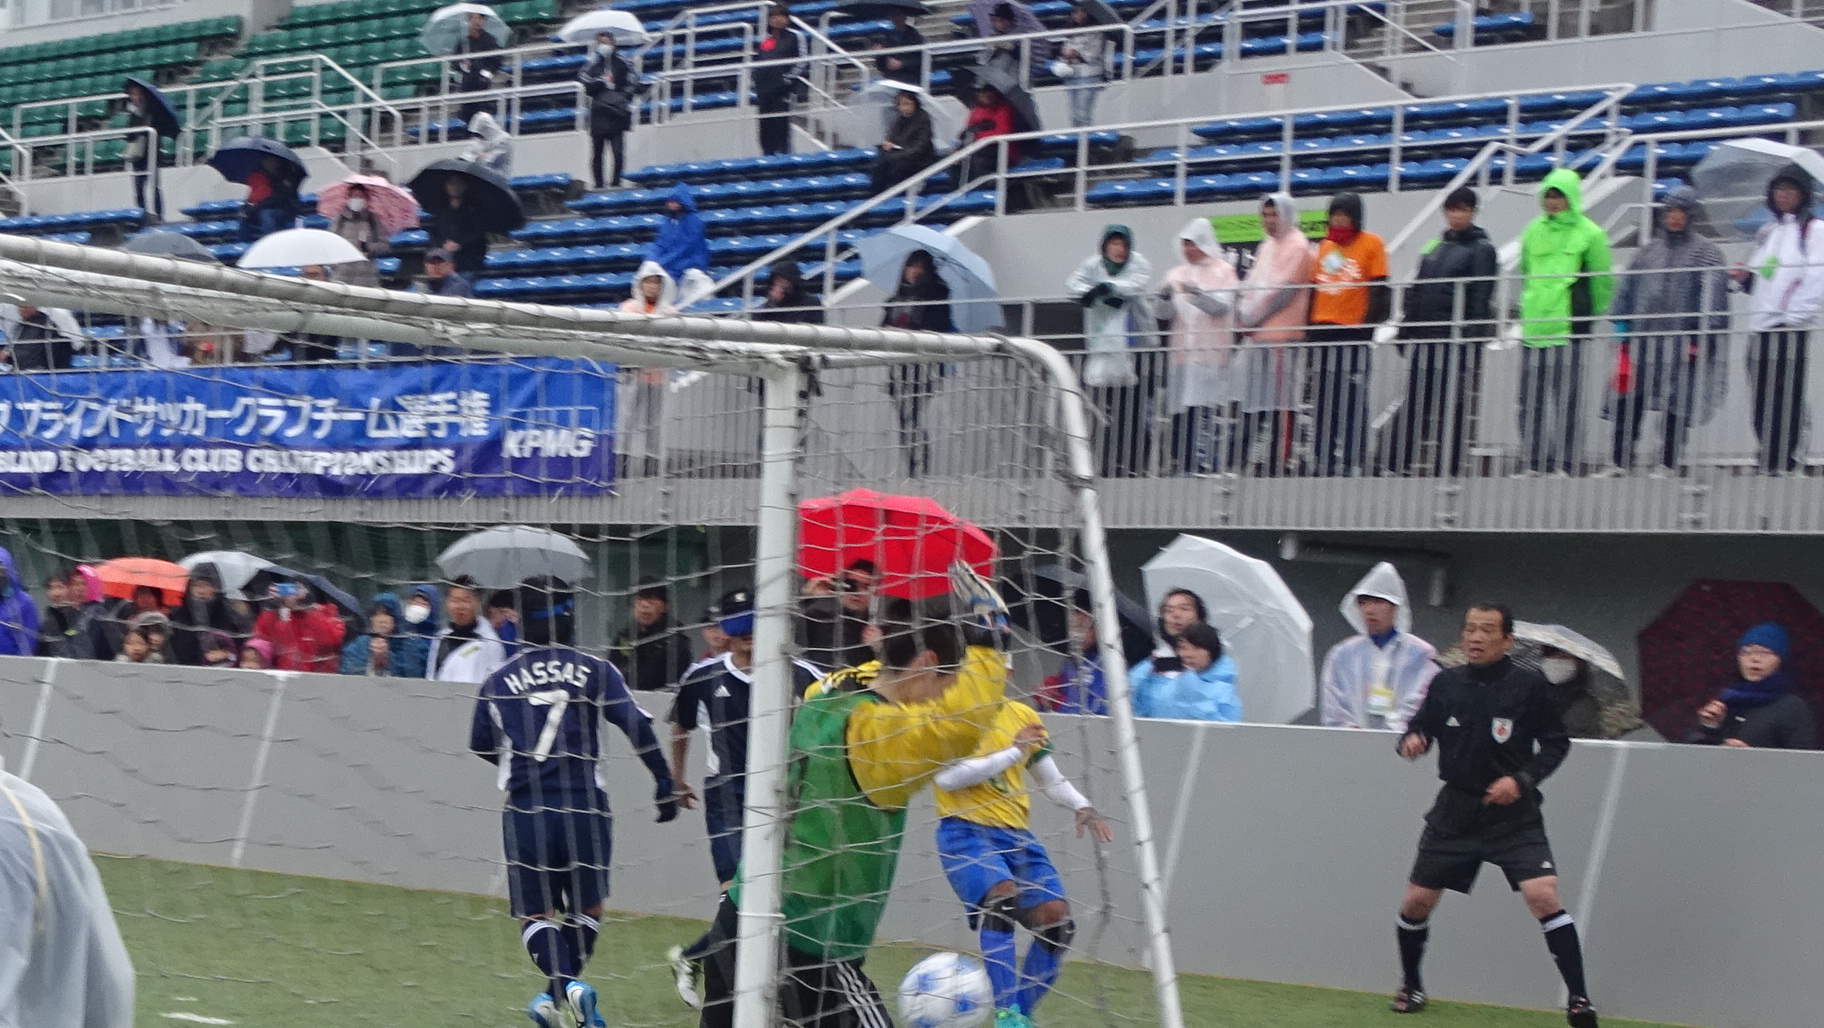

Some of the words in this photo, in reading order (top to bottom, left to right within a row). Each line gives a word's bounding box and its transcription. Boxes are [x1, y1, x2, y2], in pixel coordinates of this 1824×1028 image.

[501, 427, 597, 459] KPMG
[59, 449, 180, 473] FOOTBALL
[180, 448, 243, 473] CLUB
[245, 448, 456, 475] CHAMPIONSHIPS
[503, 660, 592, 695] HASSAS
[528, 689, 571, 763] 7
